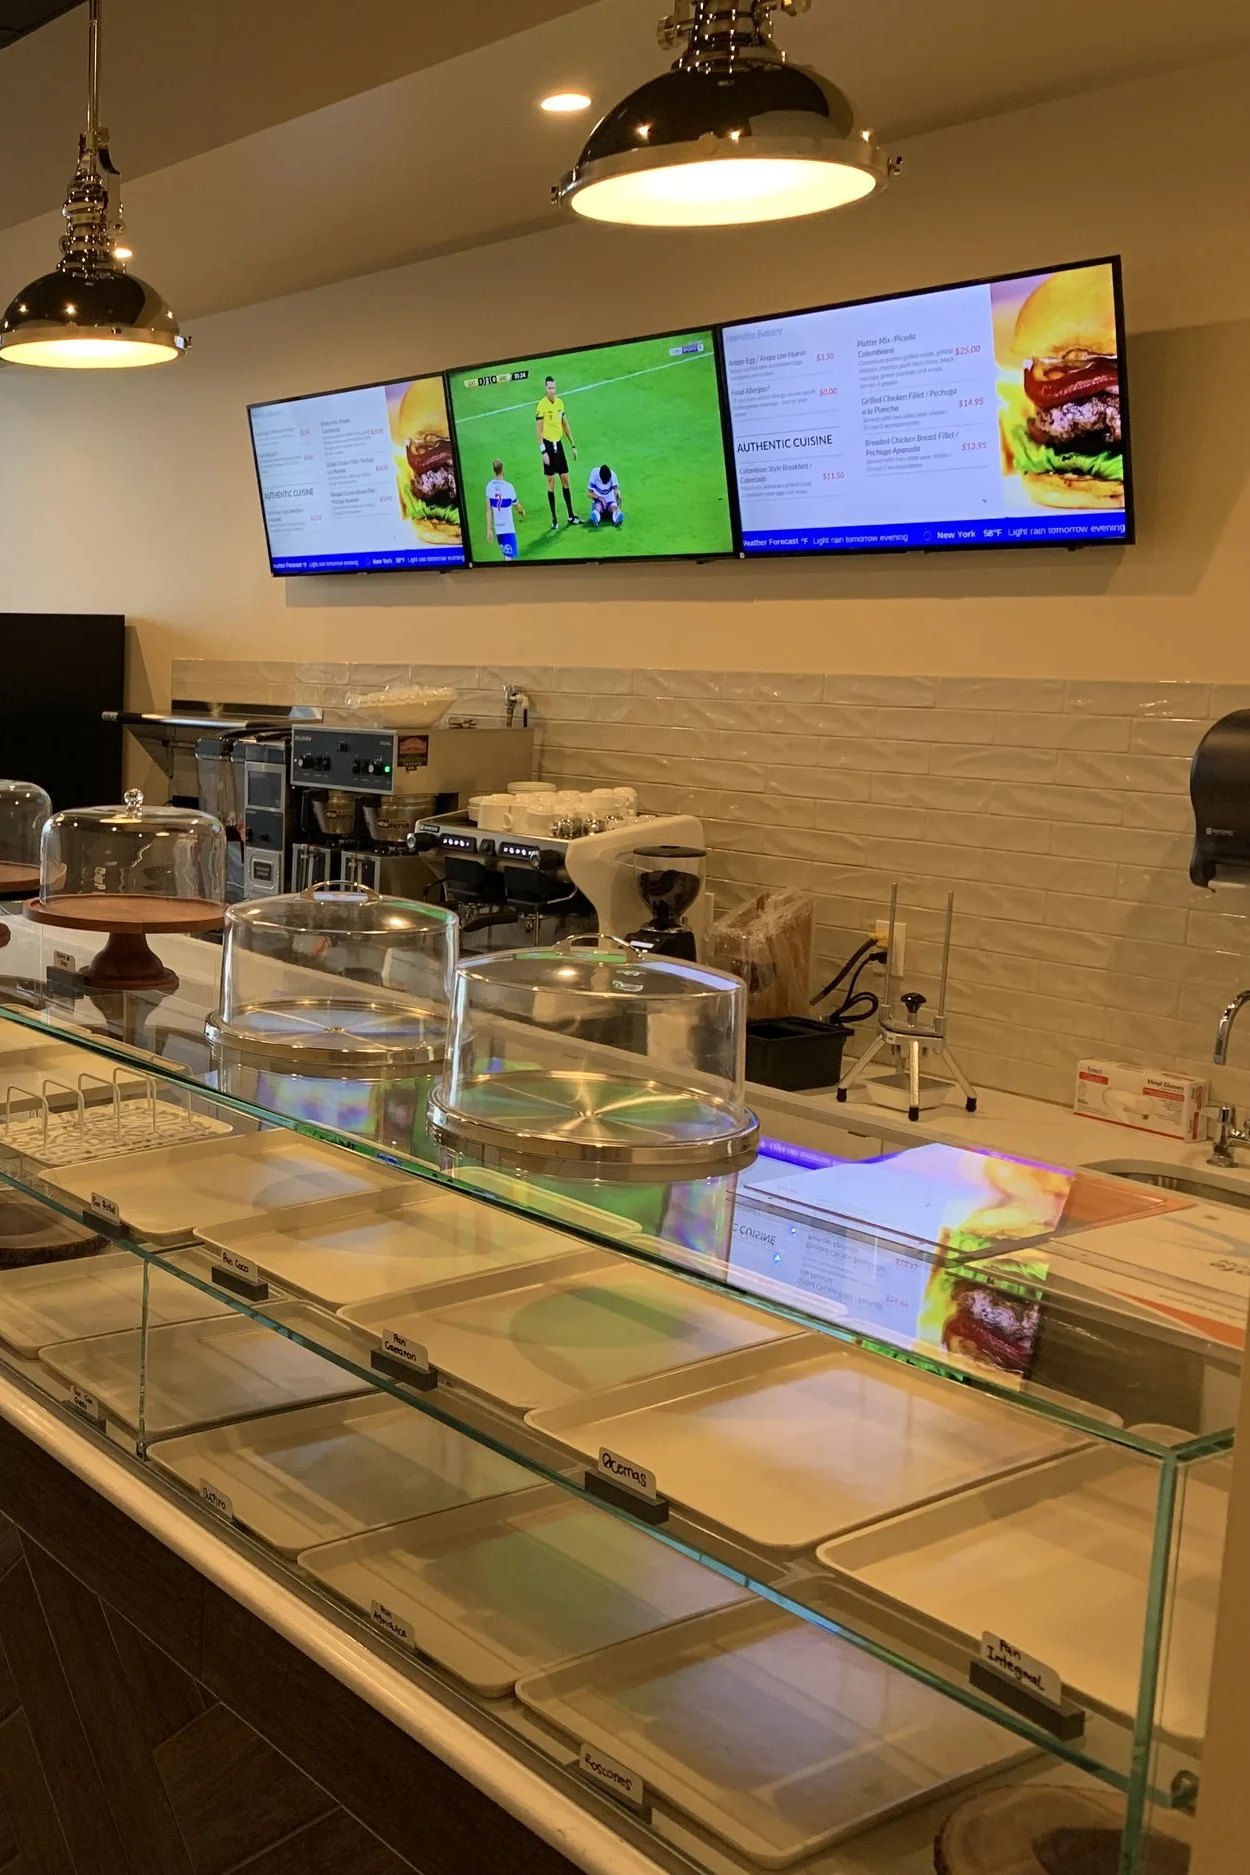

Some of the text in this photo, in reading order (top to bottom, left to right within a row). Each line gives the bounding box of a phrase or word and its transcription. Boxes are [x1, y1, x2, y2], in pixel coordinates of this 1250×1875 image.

[955, 345, 981, 356] $25.00
[737, 434, 833, 453] AUTHENTIC CUISINE
[768, 537, 799, 546] Forecast
[813, 536, 830, 547] Light
[845, 534, 878, 544] tomorrow
[879, 533, 909, 544] evening
[937, 522, 1126, 540] New York 58°F Light rain tomorrow evening
[1147, 1079, 1184, 1091] Vinyl Gloves
[222, 1252, 249, 1273] Pan Coco
[393, 1333, 406, 1347] Pan
[384, 1341, 417, 1362] Camaron
[999, 1639, 1021, 1661] Pan
[986, 1645, 1045, 1691] Integral
[584, 1753, 632, 1792] Roscones
